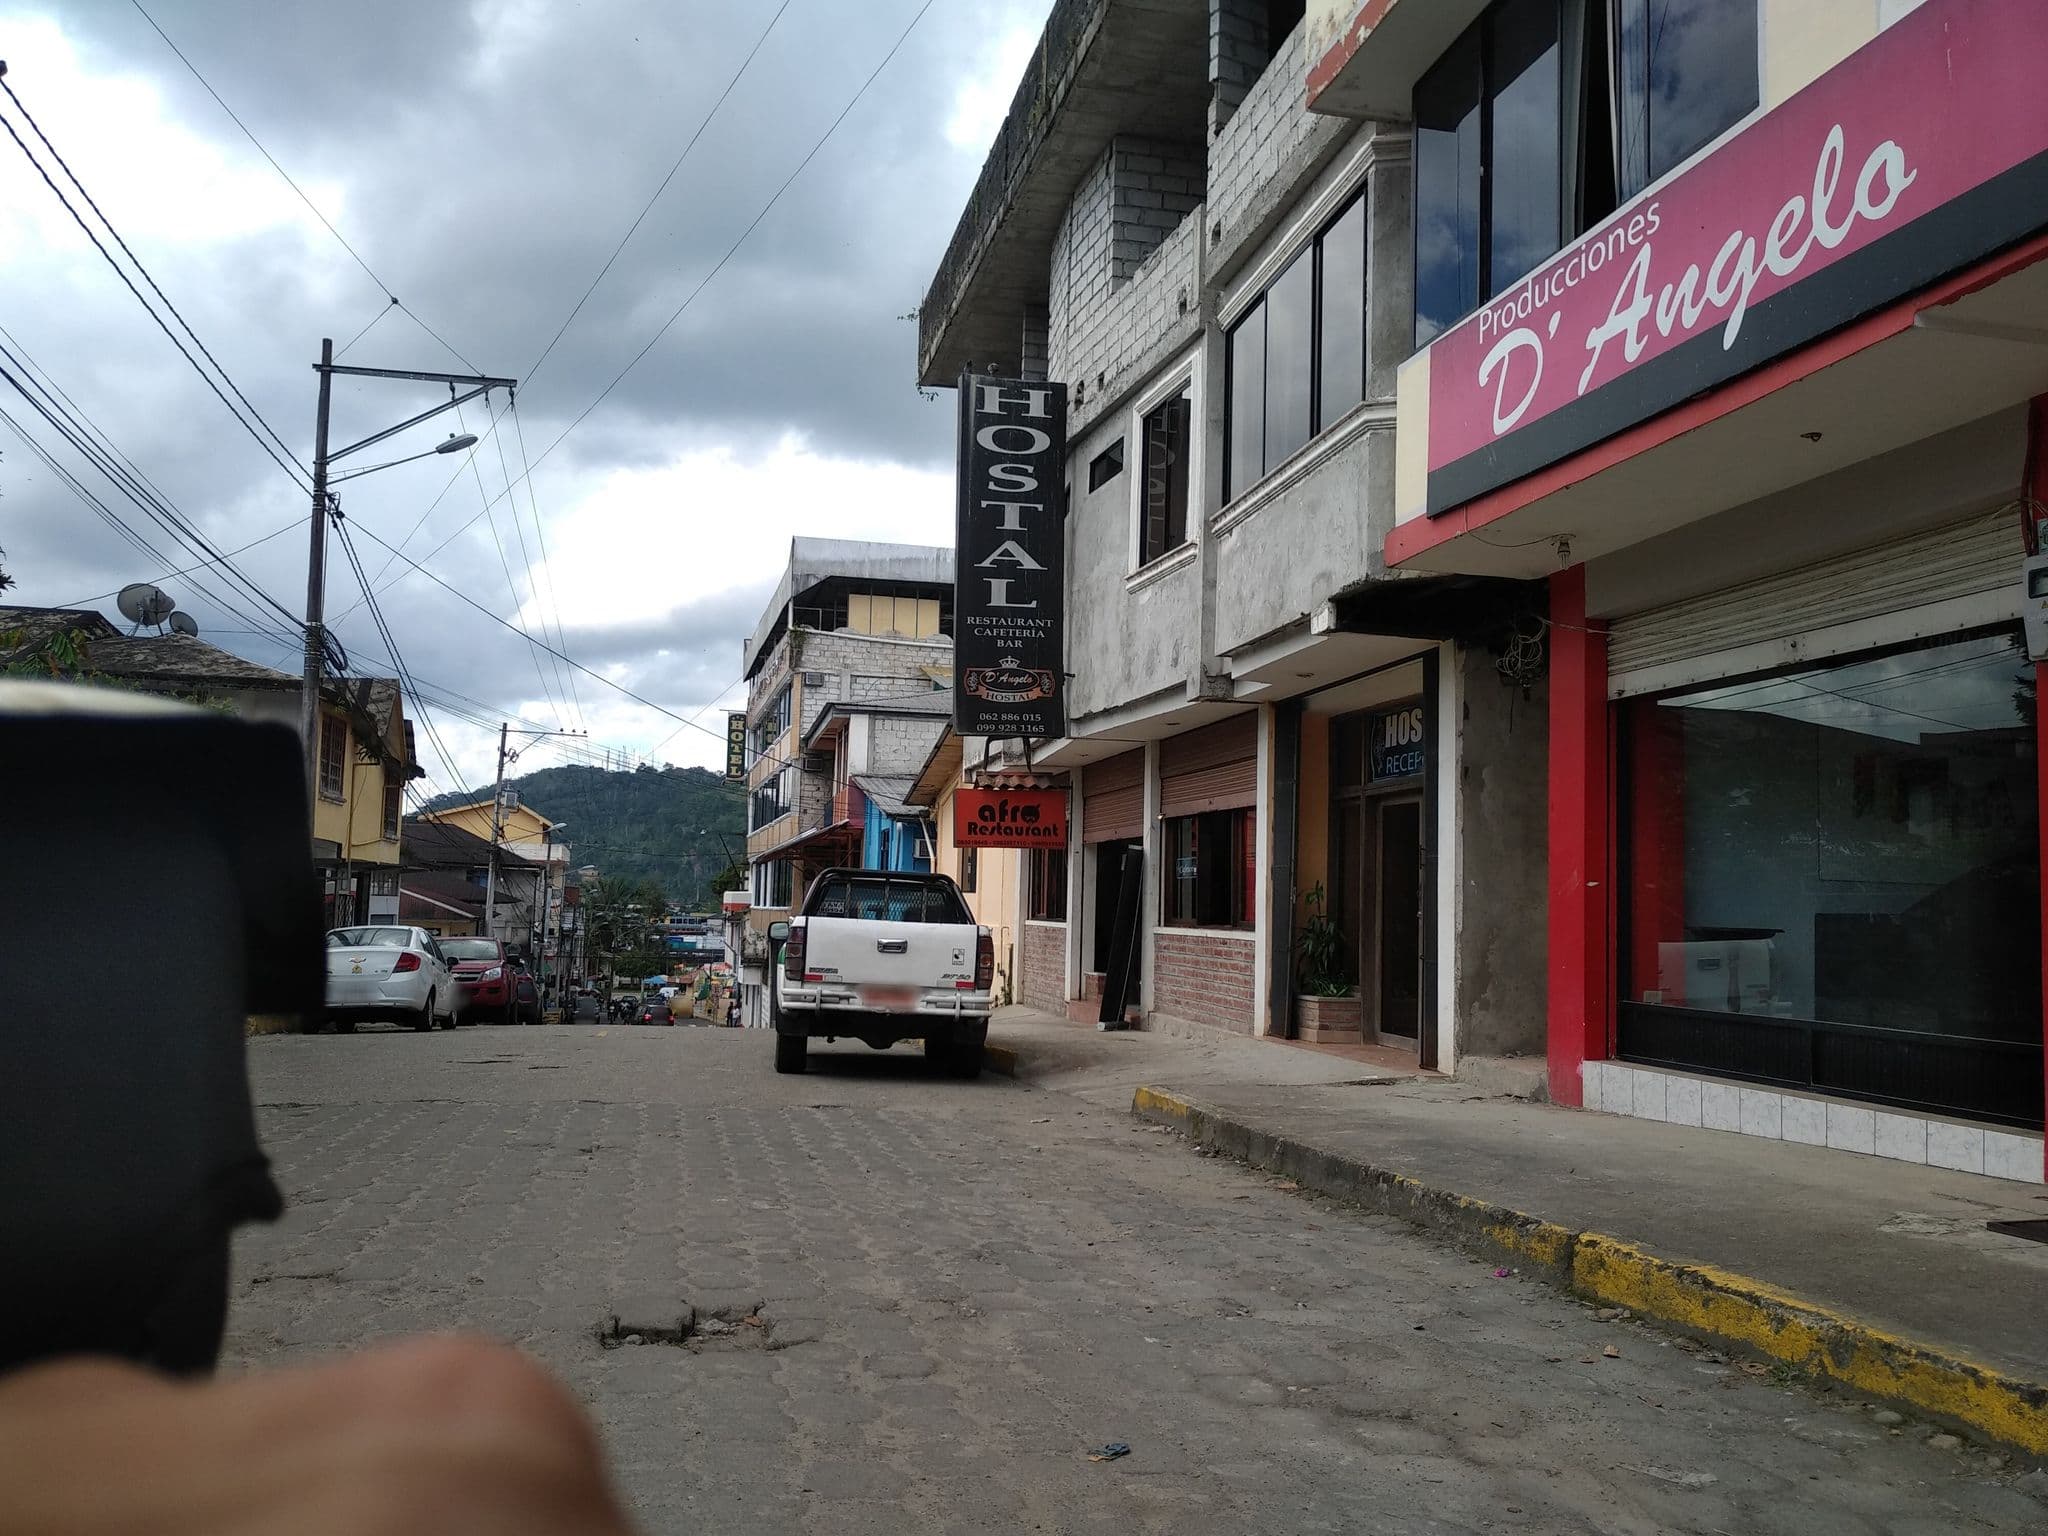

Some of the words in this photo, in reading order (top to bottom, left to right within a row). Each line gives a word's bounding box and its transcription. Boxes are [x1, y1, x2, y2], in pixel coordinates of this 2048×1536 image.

[1478, 198, 1662, 345] Producciones
[974, 383, 1053, 609] HOSTAL
[966, 615, 1054, 628] RESTAURANT
[996, 639, 1023, 648] BAR
[985, 691, 1031, 702] HOSTAL
[979, 712, 999, 722] 062
[1001, 712, 1020, 722] 886
[1022, 713, 1042, 723] 015
[976, 723, 996, 732] 099
[998, 723, 1017, 733] 928
[1020, 724, 1045, 733] 1165
[729, 720, 745, 776] HOTEL
[977, 798, 1041, 825] afro
[967, 821, 1059, 837] Restaurant
